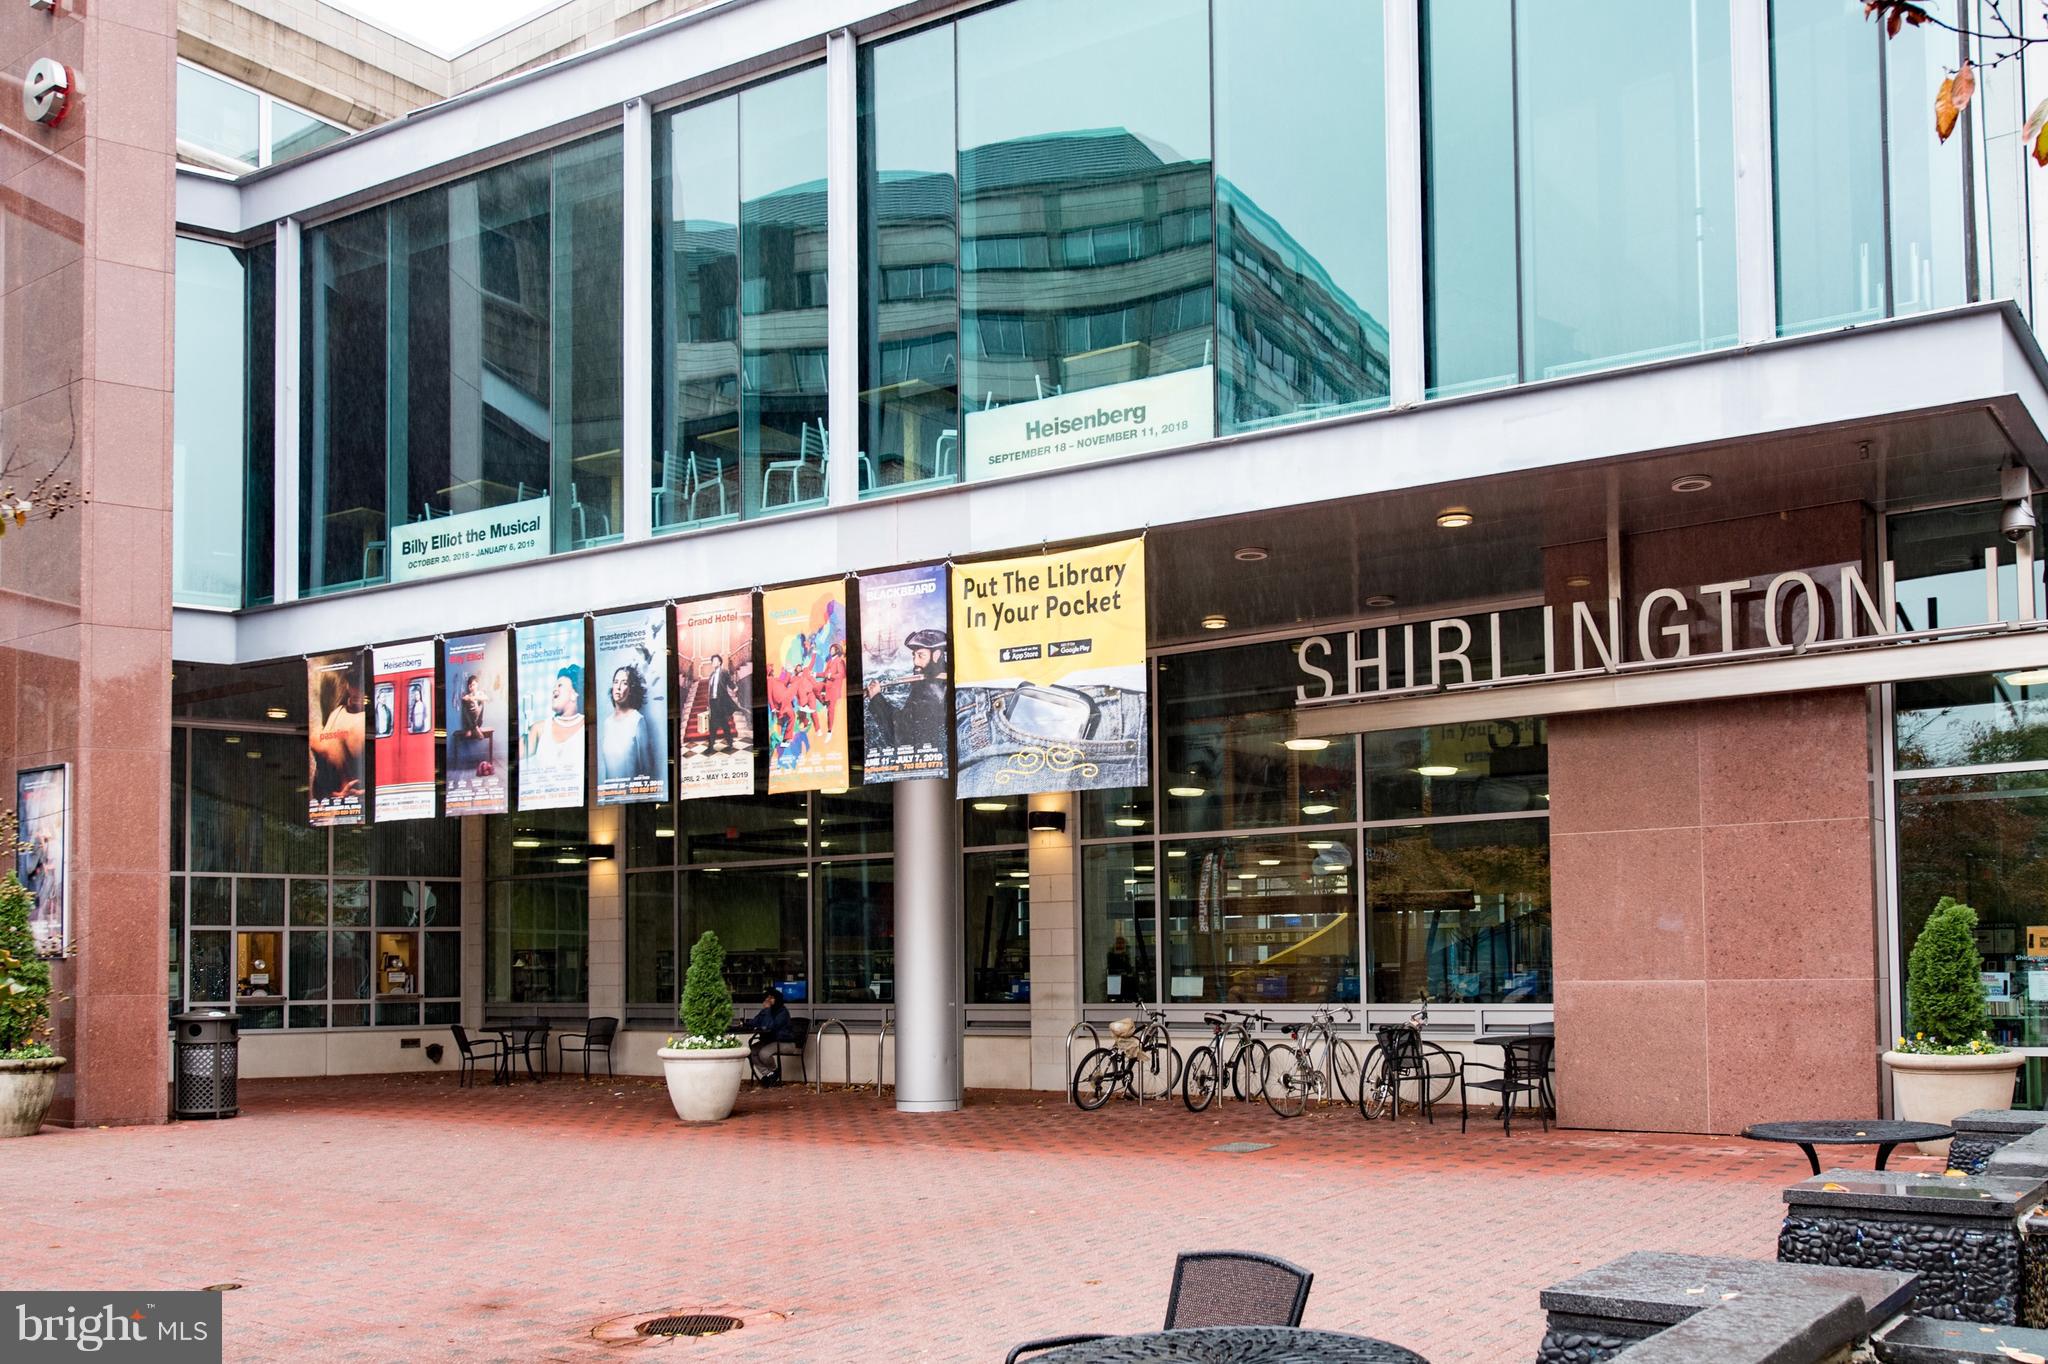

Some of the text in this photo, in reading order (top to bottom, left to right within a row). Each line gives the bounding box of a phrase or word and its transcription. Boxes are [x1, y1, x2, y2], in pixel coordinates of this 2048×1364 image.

[1026, 405, 1146, 441] Heisenberg
[988, 445, 1051, 465] SEPTEMBER
[1055, 443, 1067, 453] 18
[1077, 429, 1138, 449] NOVEMBER
[1141, 426, 1158, 438] 11,
[1161, 420, 1189, 434] 2018
[402, 516, 541, 556] Billy Elliot the Musical
[408, 557, 439, 569] OCTOBER
[453, 552, 470, 561] 2018
[476, 545, 507, 557] JANUARY
[518, 540, 535, 549] 2019
[866, 583, 936, 600] BLACKBEARD
[963, 577, 998, 600] Put
[1003, 570, 1040, 595] The
[1047, 563, 1126, 589] Library
[688, 616, 713, 627] Grand
[715, 612, 738, 623] Hotel
[967, 590, 1121, 631] In Your Pocket
[600, 630, 646, 641] masterpieces
[1297, 560, 1896, 702] SHIRLINGTON
[1024, 651, 1038, 659] Store
[1060, 646, 1079, 654] Google
[383, 658, 422, 670] Heisenberg
[896, 755, 914, 763] JULY
[924, 754, 943, 762] 2019
